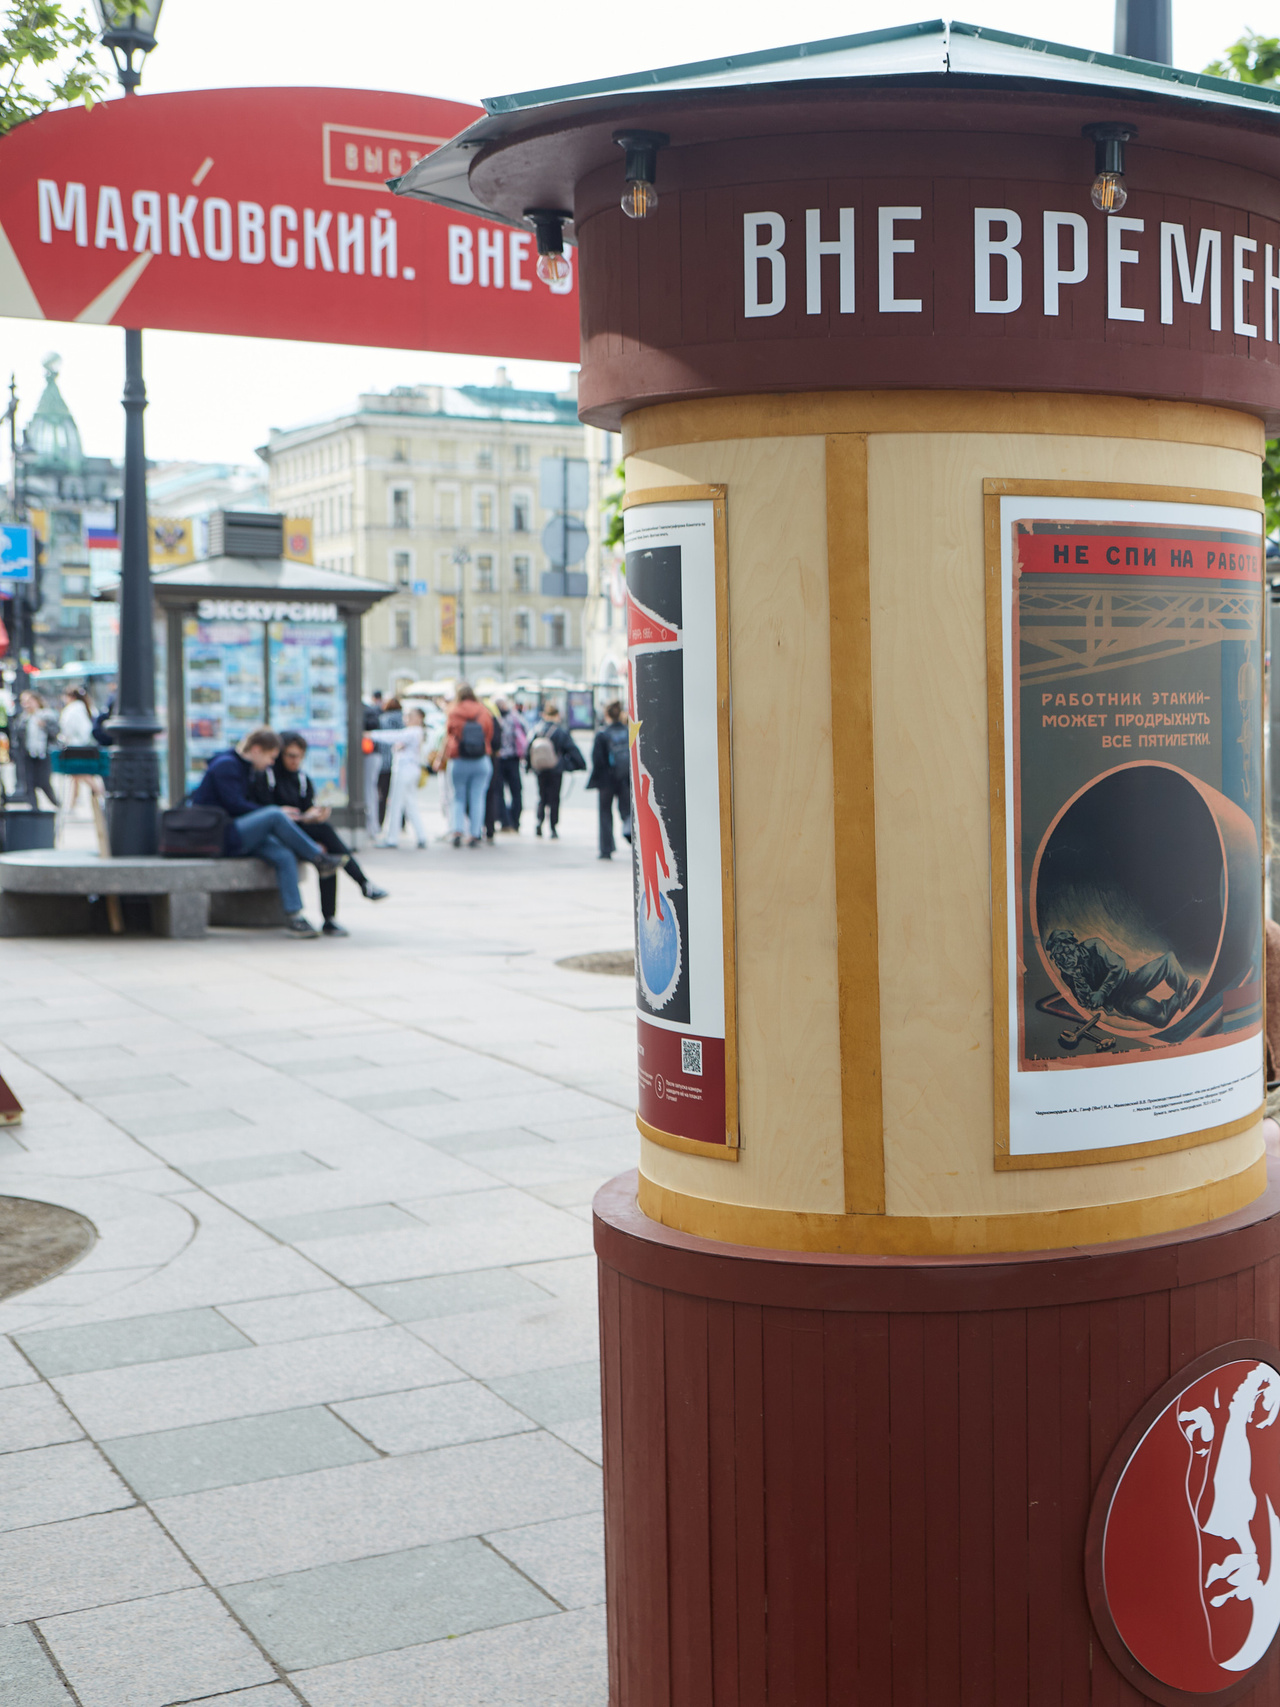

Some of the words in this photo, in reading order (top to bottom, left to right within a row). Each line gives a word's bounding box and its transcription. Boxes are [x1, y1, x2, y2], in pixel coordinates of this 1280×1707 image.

[344, 142, 422, 177] ВЫСТ
[37, 178, 416, 281] МАЯКОВСКИЙ.
[448, 224, 533, 292] ВНЕ
[743, 206, 923, 318] ВНЕ
[1053, 544, 1089, 565] НЕ
[1105, 546, 1156, 566] СПИ
[1170, 549, 1194, 568] НА
[198, 599, 338, 622] ЭКСКУРСИИ
[1041, 693, 1142, 707] РАБОТНИК
[1042, 714, 1108, 728] МОЖЕТ
[1115, 712, 1211, 728] ПРОДРЫХНУТЬ
[1102, 735, 1132, 748] ВСЕ
[1138, 732, 1211, 748] ПЯТИЛЕТКИ.
